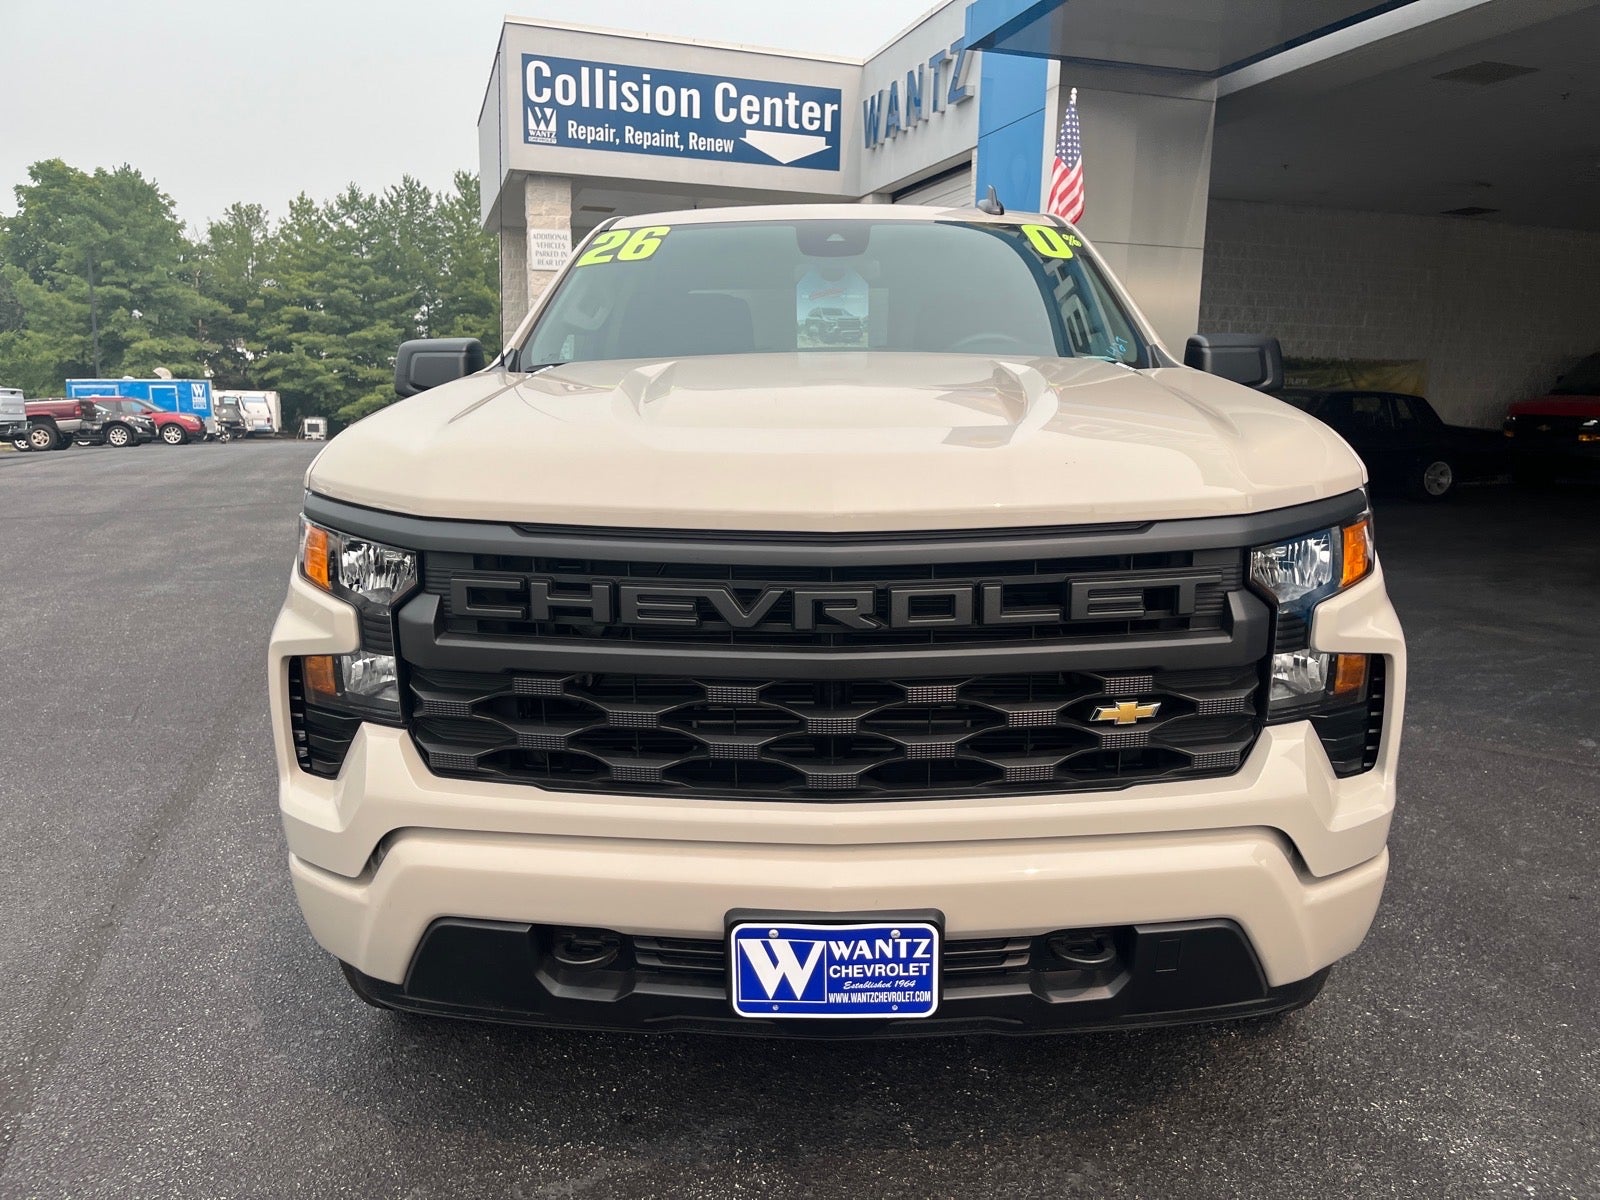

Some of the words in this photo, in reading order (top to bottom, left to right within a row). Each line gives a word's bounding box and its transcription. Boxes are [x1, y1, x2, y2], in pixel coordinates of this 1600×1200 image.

[526, 60, 701, 120] Collision
[714, 82, 839, 132] Center
[863, 38, 971, 149] WANTZ
[528, 129, 557, 139] WANTZ
[568, 120, 620, 145] Repair,
[624, 125, 684, 151] Repaint,
[689, 131, 734, 153] Renew
[533, 233, 568, 241] ADDITIONAL
[577, 226, 671, 266] 26
[449, 572, 1223, 631] CHEVROLET
[828, 938, 931, 961] WANTZ
[829, 962, 930, 978] CHEVROLET
[843, 980, 892, 990] Established
[894, 979, 916, 988] 1964
[828, 990, 931, 1004] WWW.WANTZCHEVROLET.COM
